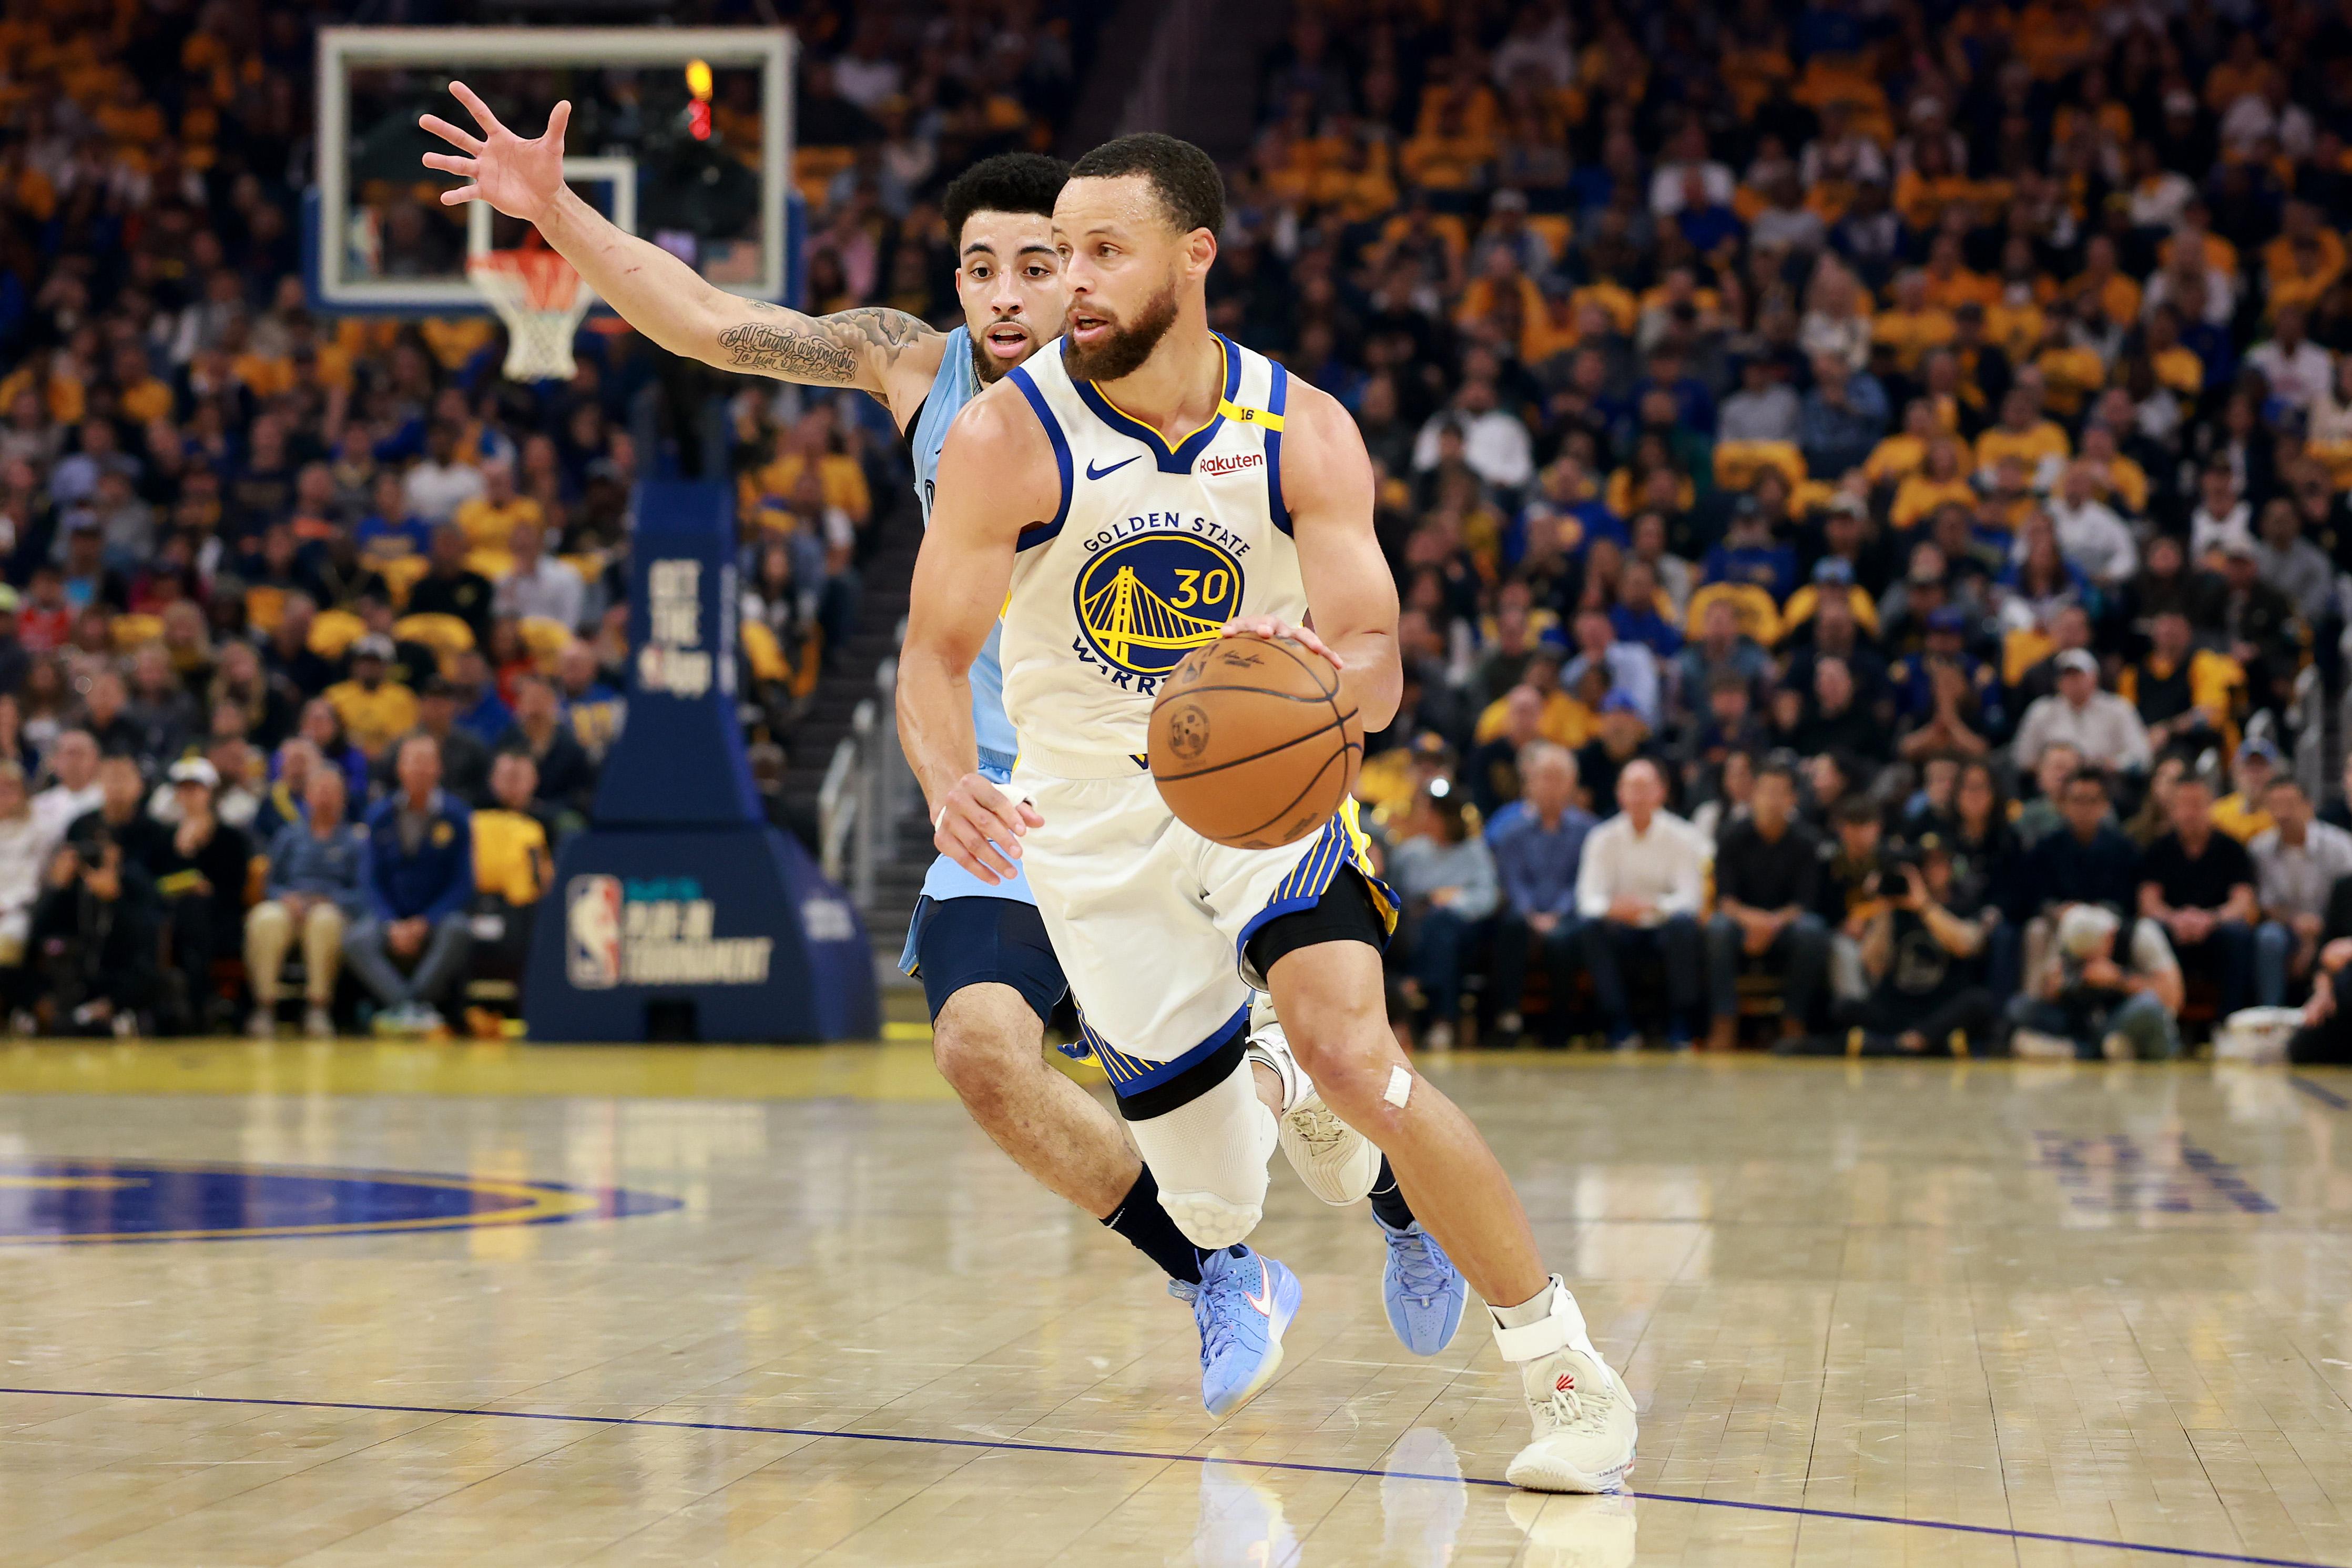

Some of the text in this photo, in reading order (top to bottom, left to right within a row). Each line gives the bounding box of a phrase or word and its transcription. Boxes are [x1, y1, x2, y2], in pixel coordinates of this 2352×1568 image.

[720, 325, 758, 349] All
[757, 328, 798, 359] things
[798, 340, 817, 358] are
[752, 351, 778, 369] him
[1241, 409, 1255, 420] 16
[1200, 454, 1263, 473] Rakuten
[1083, 512, 1251, 557] GOLDEN STATE
[1170, 568, 1229, 609] 30
[1072, 634, 1167, 697] WARR
